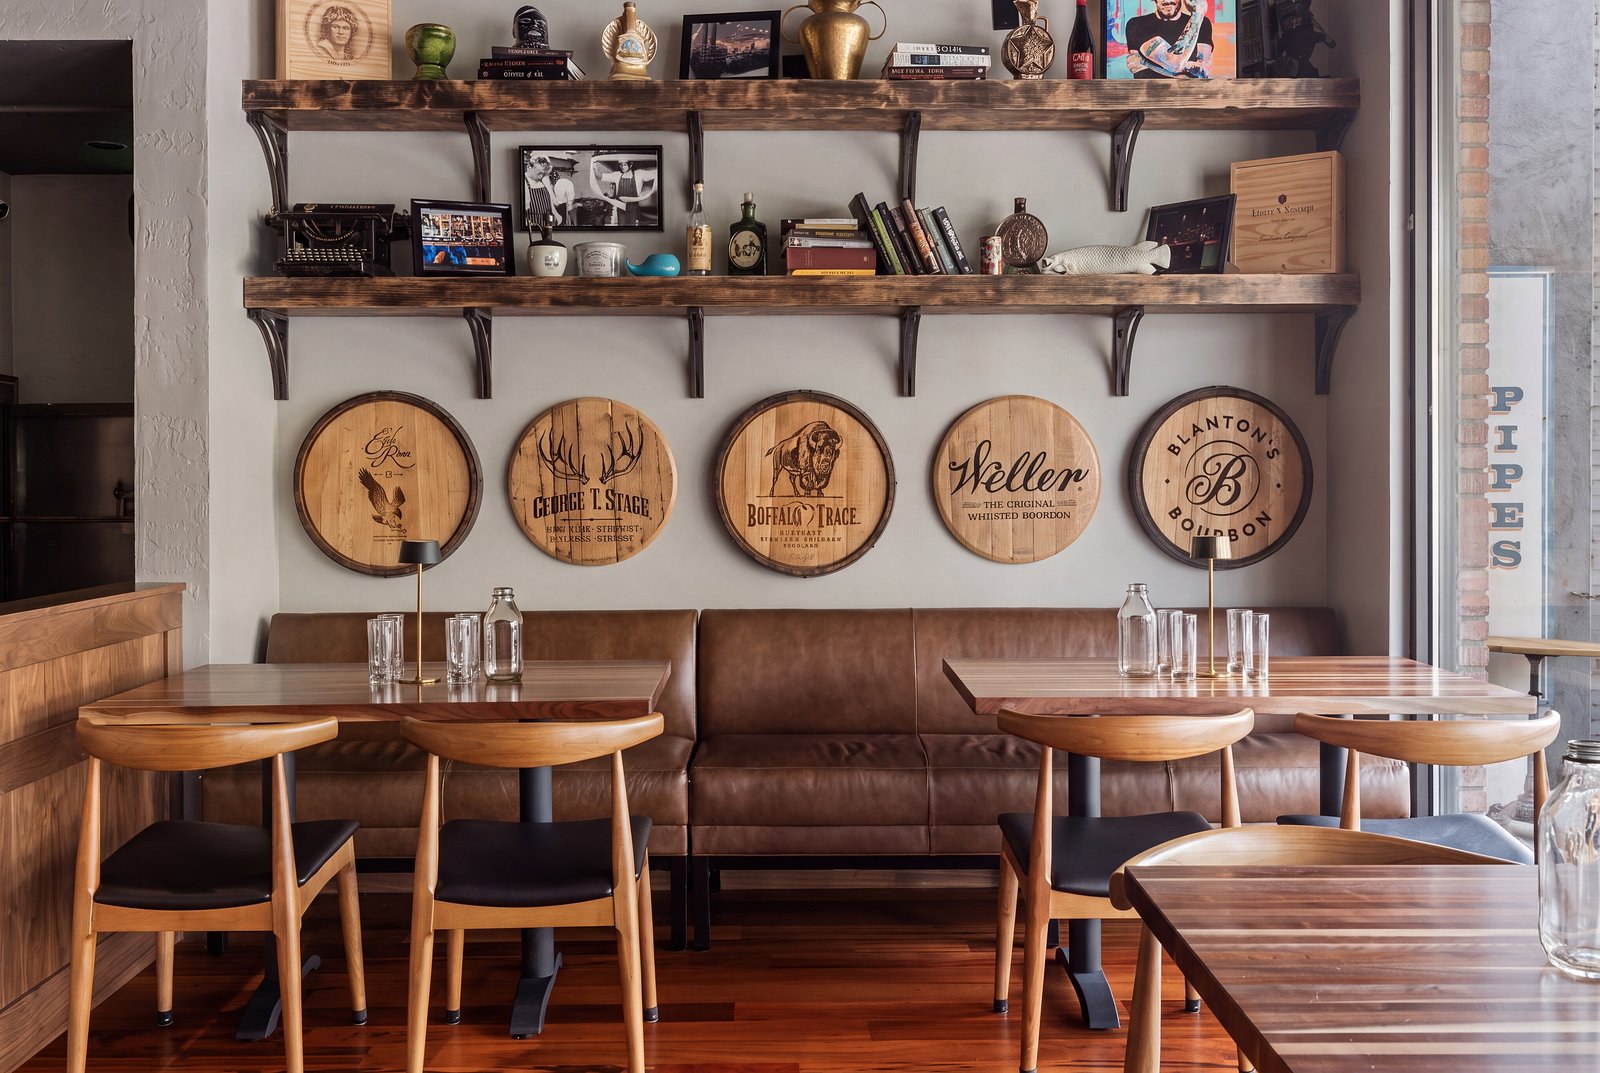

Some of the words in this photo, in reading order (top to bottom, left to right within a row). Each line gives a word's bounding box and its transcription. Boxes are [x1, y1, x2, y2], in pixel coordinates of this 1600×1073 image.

[1167, 415, 1280, 460] BLANTON'S
[948, 439, 1090, 496] Weller
[1488, 386, 1524, 570] PIPES
[533, 491, 585, 519] GEORGE
[589, 488, 602, 510] T.
[815, 503, 857, 528] TRACE
[983, 501, 1004, 509] THE
